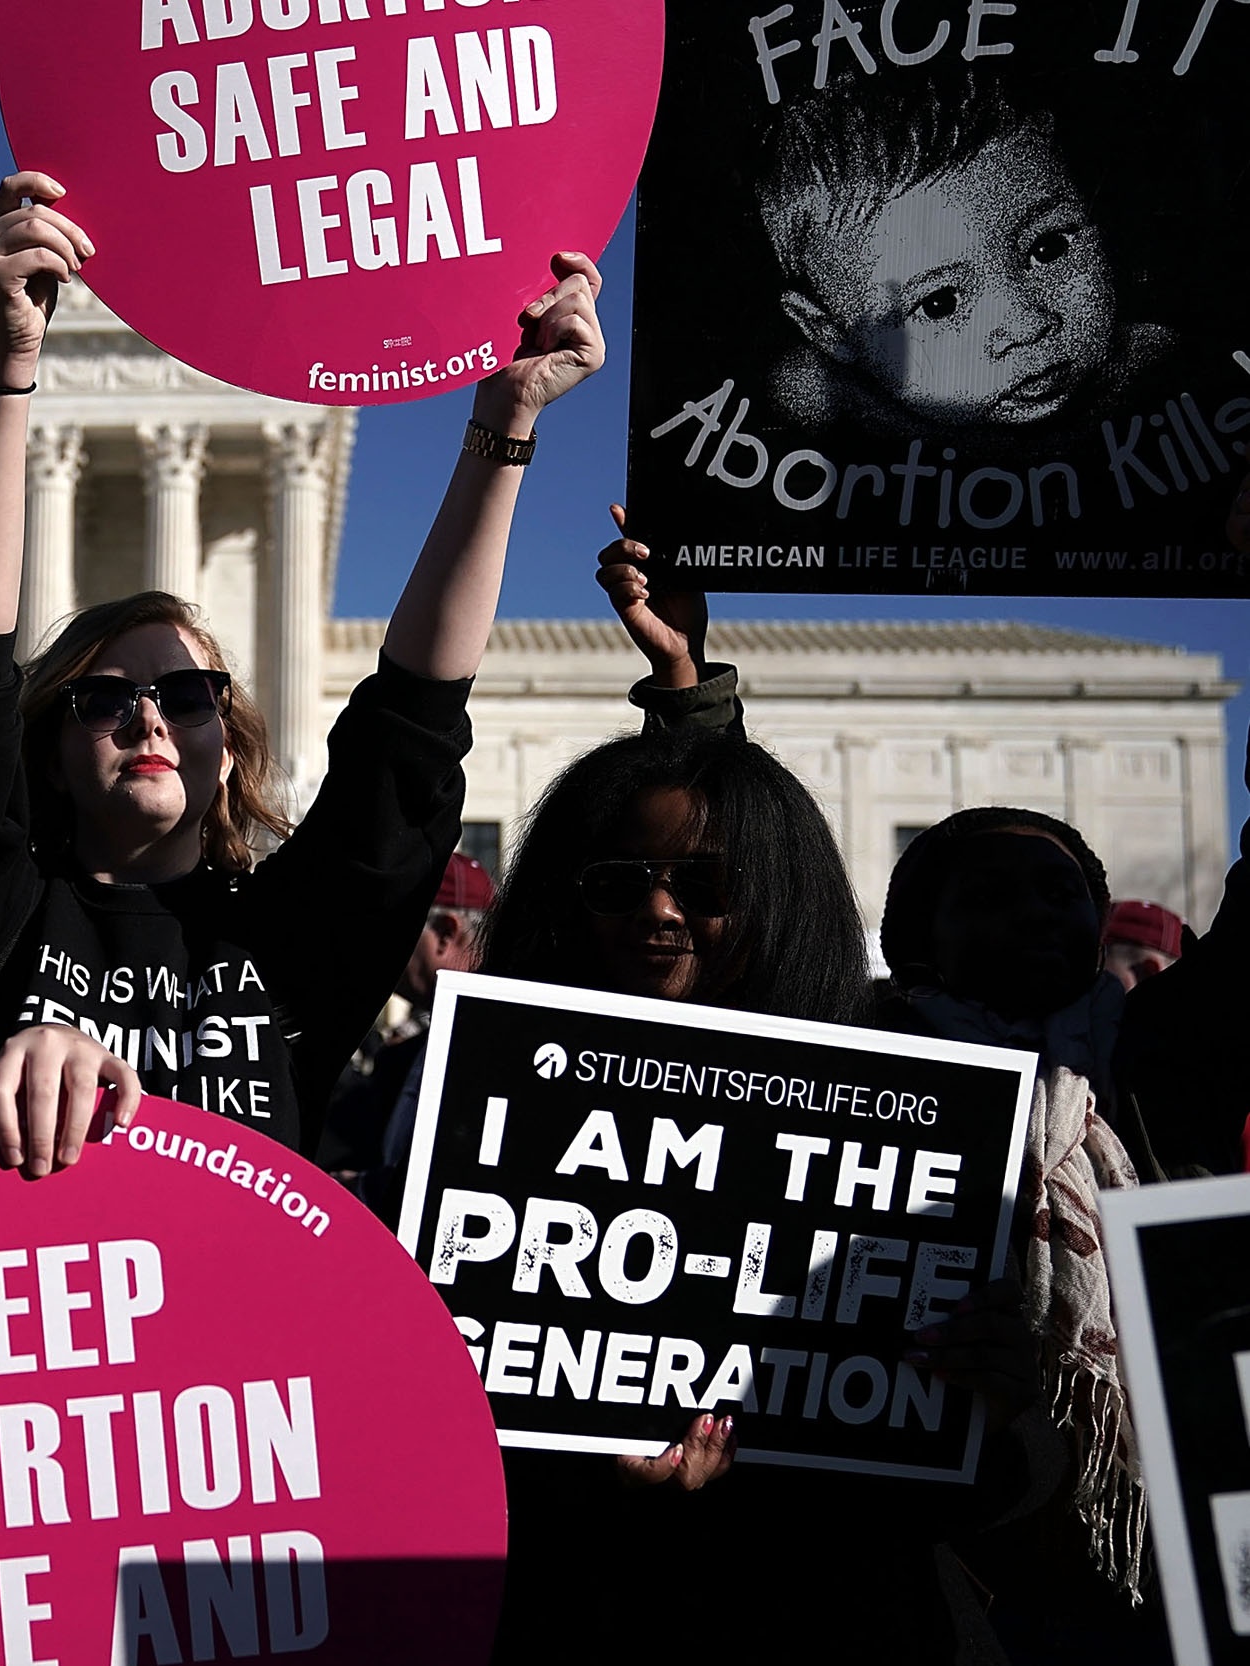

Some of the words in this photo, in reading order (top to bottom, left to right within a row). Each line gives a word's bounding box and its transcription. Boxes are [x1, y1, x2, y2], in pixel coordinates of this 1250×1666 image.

[149, 46, 367, 174] SAFE
[404, 24, 558, 140] AND
[749, 0, 1016, 104] FACE
[249, 156, 503, 286] LEGAL
[308, 341, 499, 392] feminist.org
[650, 379, 1082, 529] Abortion
[674, 545, 825, 568] AMERICAN
[837, 546, 899, 569] LIFE
[911, 547, 1027, 570] LEAGUE
[39, 944, 91, 998] HIS
[100, 967, 134, 1004] IS
[145, 962, 229, 1010] WHAT
[238, 960, 265, 992] A
[575, 1050, 938, 1126] STUDENTSFORLIFE.ORG
[101, 1111, 331, 1238] Foundation
[478, 1096, 509, 1167] I
[555, 1109, 724, 1192] AM
[775, 1133, 963, 1218] THE
[429, 1188, 978, 1331] PRO-LIFE
[109, 1529, 330, 1666] AND
